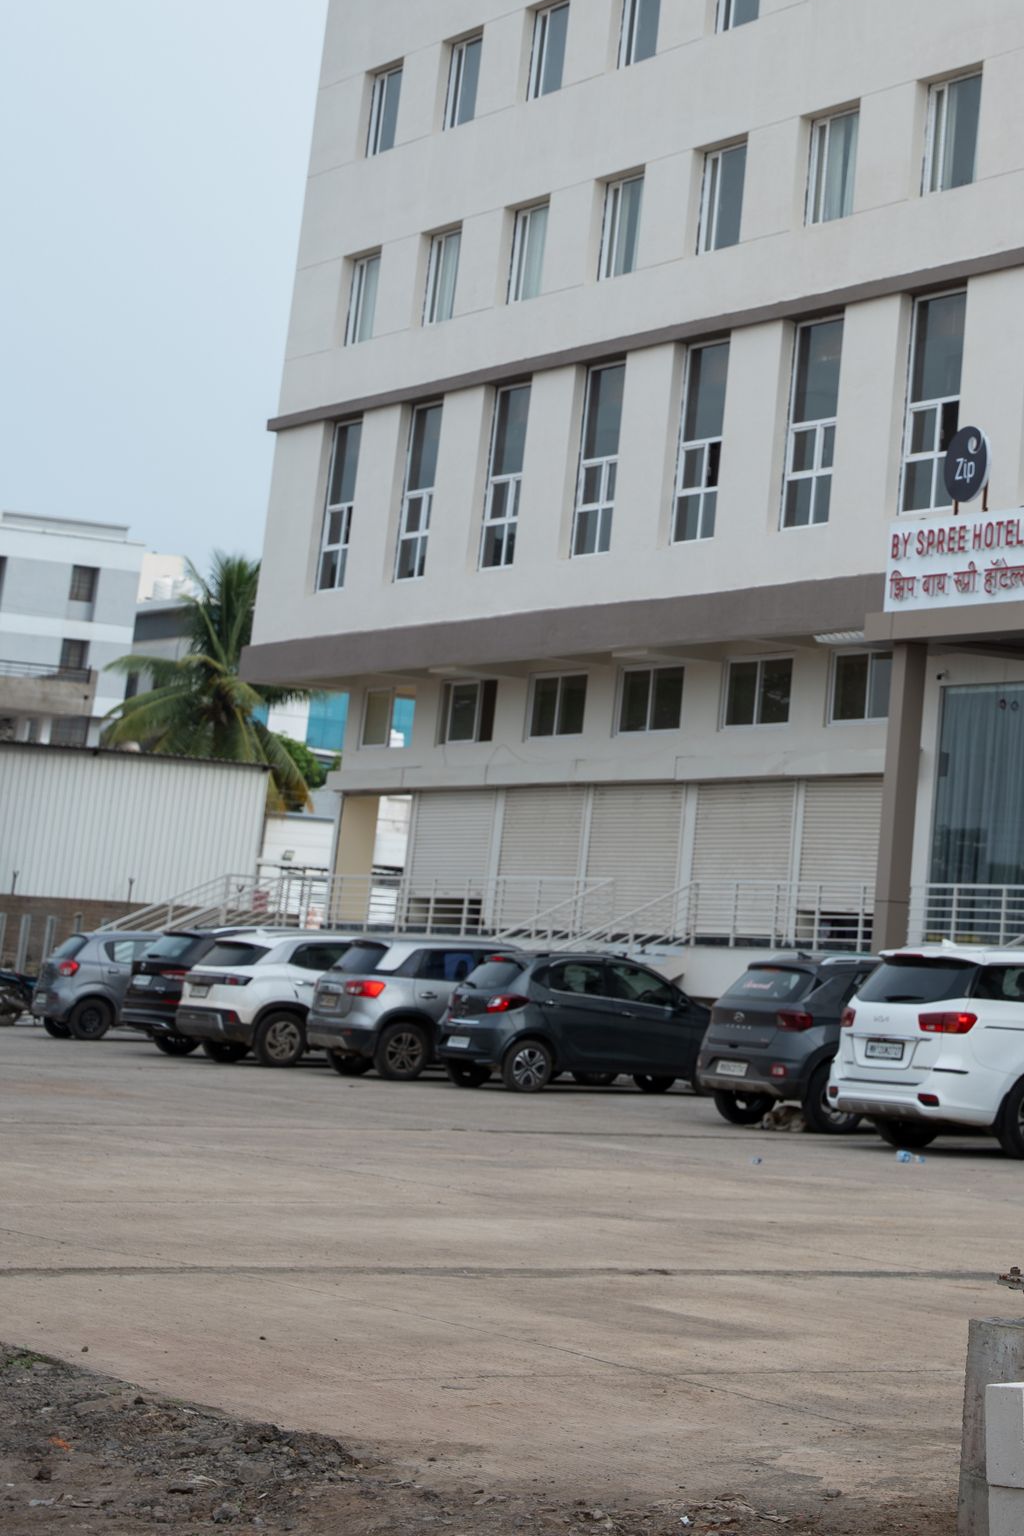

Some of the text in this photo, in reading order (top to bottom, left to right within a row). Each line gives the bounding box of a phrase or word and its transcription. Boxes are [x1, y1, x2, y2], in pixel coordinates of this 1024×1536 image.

[954, 457, 976, 482] Zip
[891, 532, 912, 559] BY
[916, 525, 967, 556] SPREE
[890, 570, 916, 600] झिप
[922, 573, 948, 594] बाय
